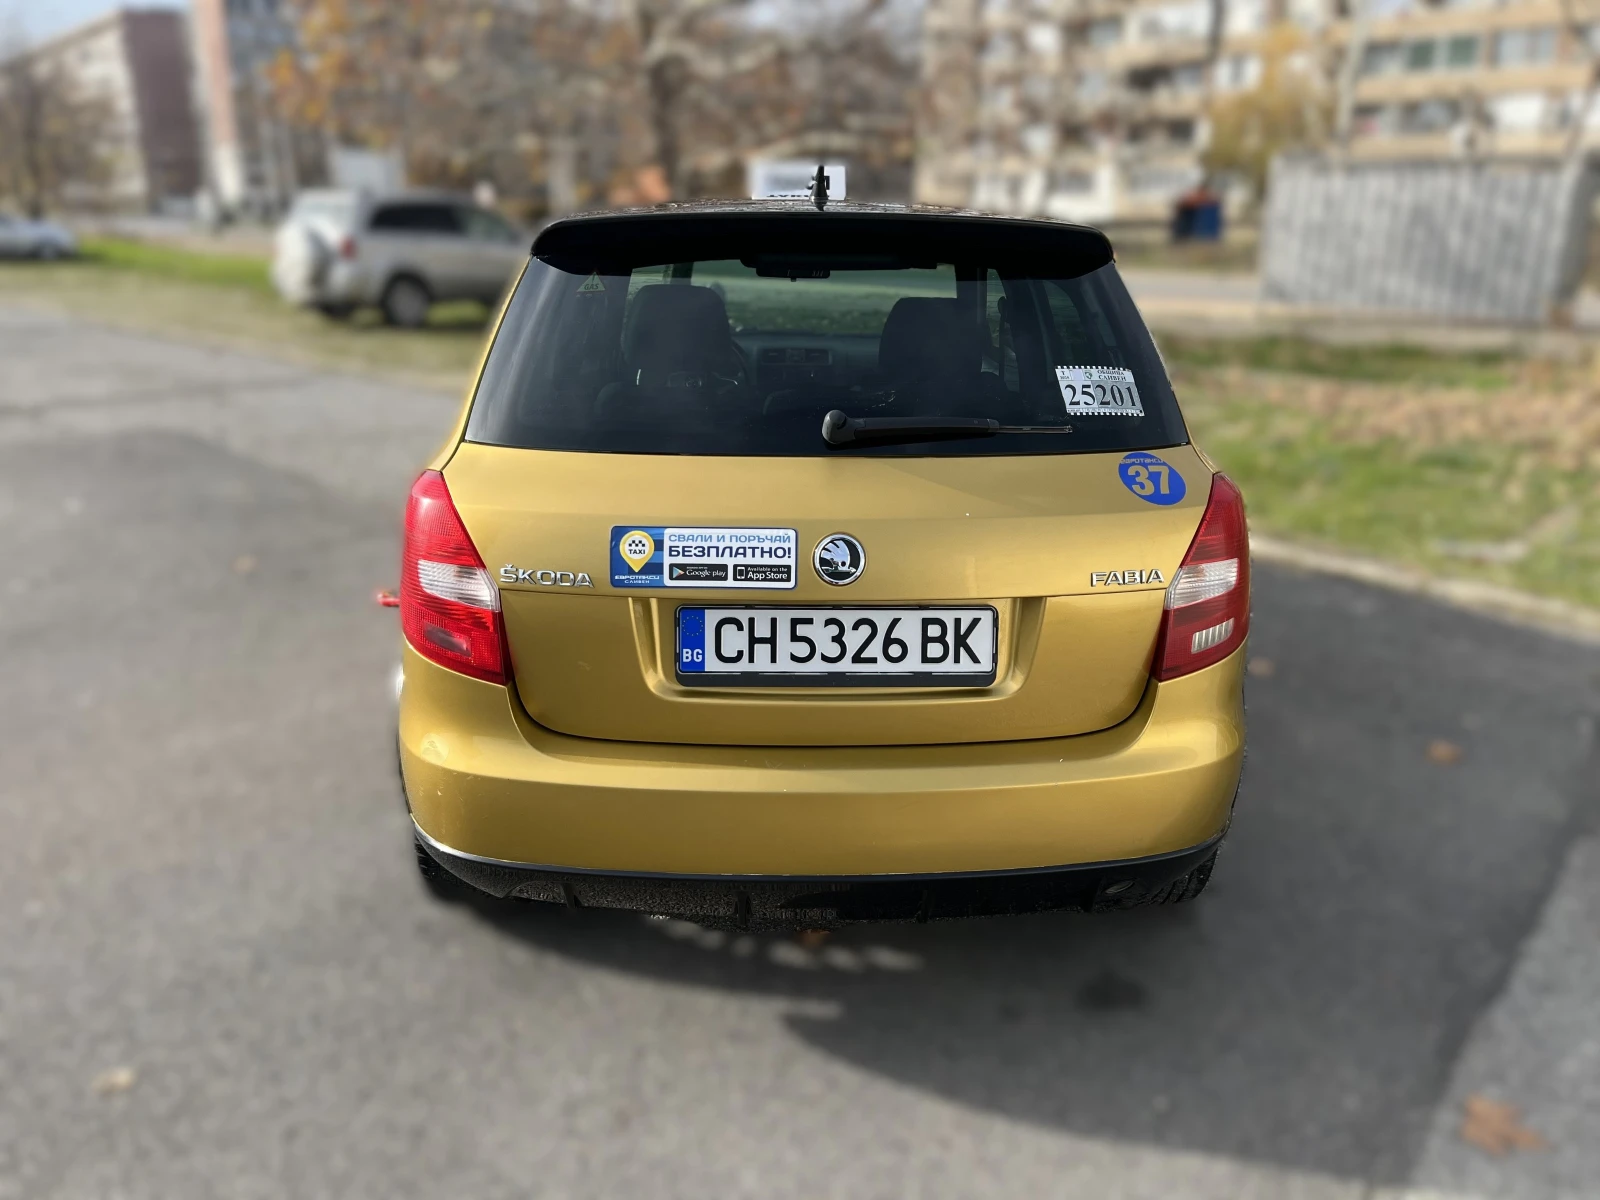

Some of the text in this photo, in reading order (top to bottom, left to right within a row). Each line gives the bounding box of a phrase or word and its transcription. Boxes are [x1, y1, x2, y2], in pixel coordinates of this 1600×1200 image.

[1064, 384, 1137, 407] 25201
[1127, 465, 1170, 496] 37
[668, 533, 791, 544] СВАЛИ И ПОРЪЧАЙ
[668, 545, 792, 559] БЕЗПЛАТНО!
[500, 563, 594, 588] ŠKODA
[686, 569, 726, 578] Google play
[747, 571, 788, 581] App Store
[1090, 569, 1165, 587] FABIA
[682, 648, 703, 662] BG
